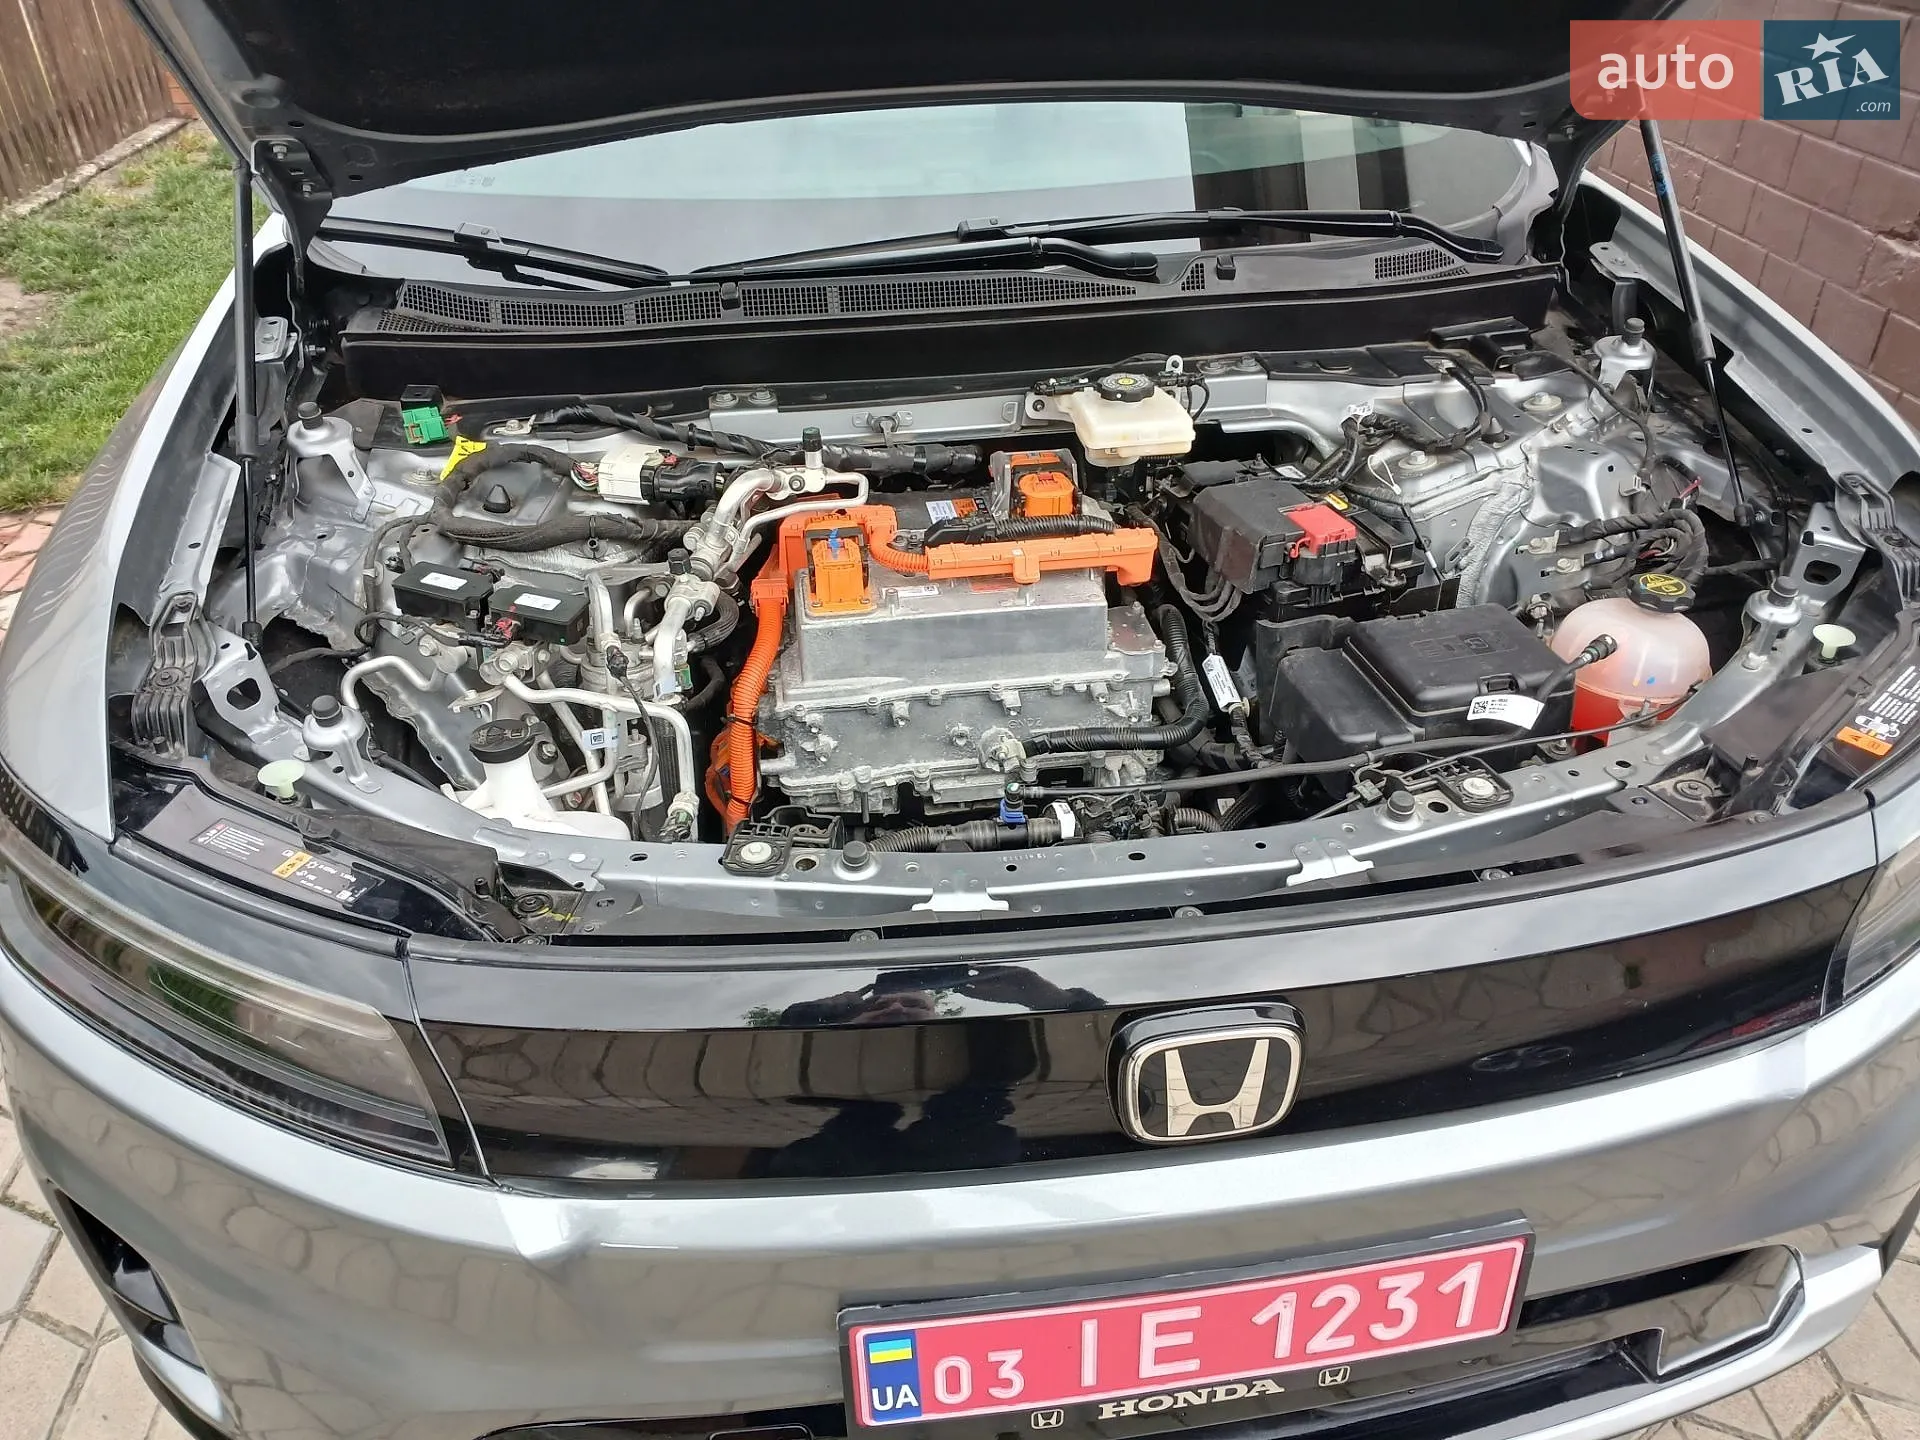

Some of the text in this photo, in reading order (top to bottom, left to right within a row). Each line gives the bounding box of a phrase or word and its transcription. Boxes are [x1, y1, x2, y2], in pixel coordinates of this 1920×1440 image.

[934, 1260, 1484, 1404] 03 IE 1231
[872, 1384, 919, 1411] UA
[1098, 1379, 1285, 1419] HONDA
